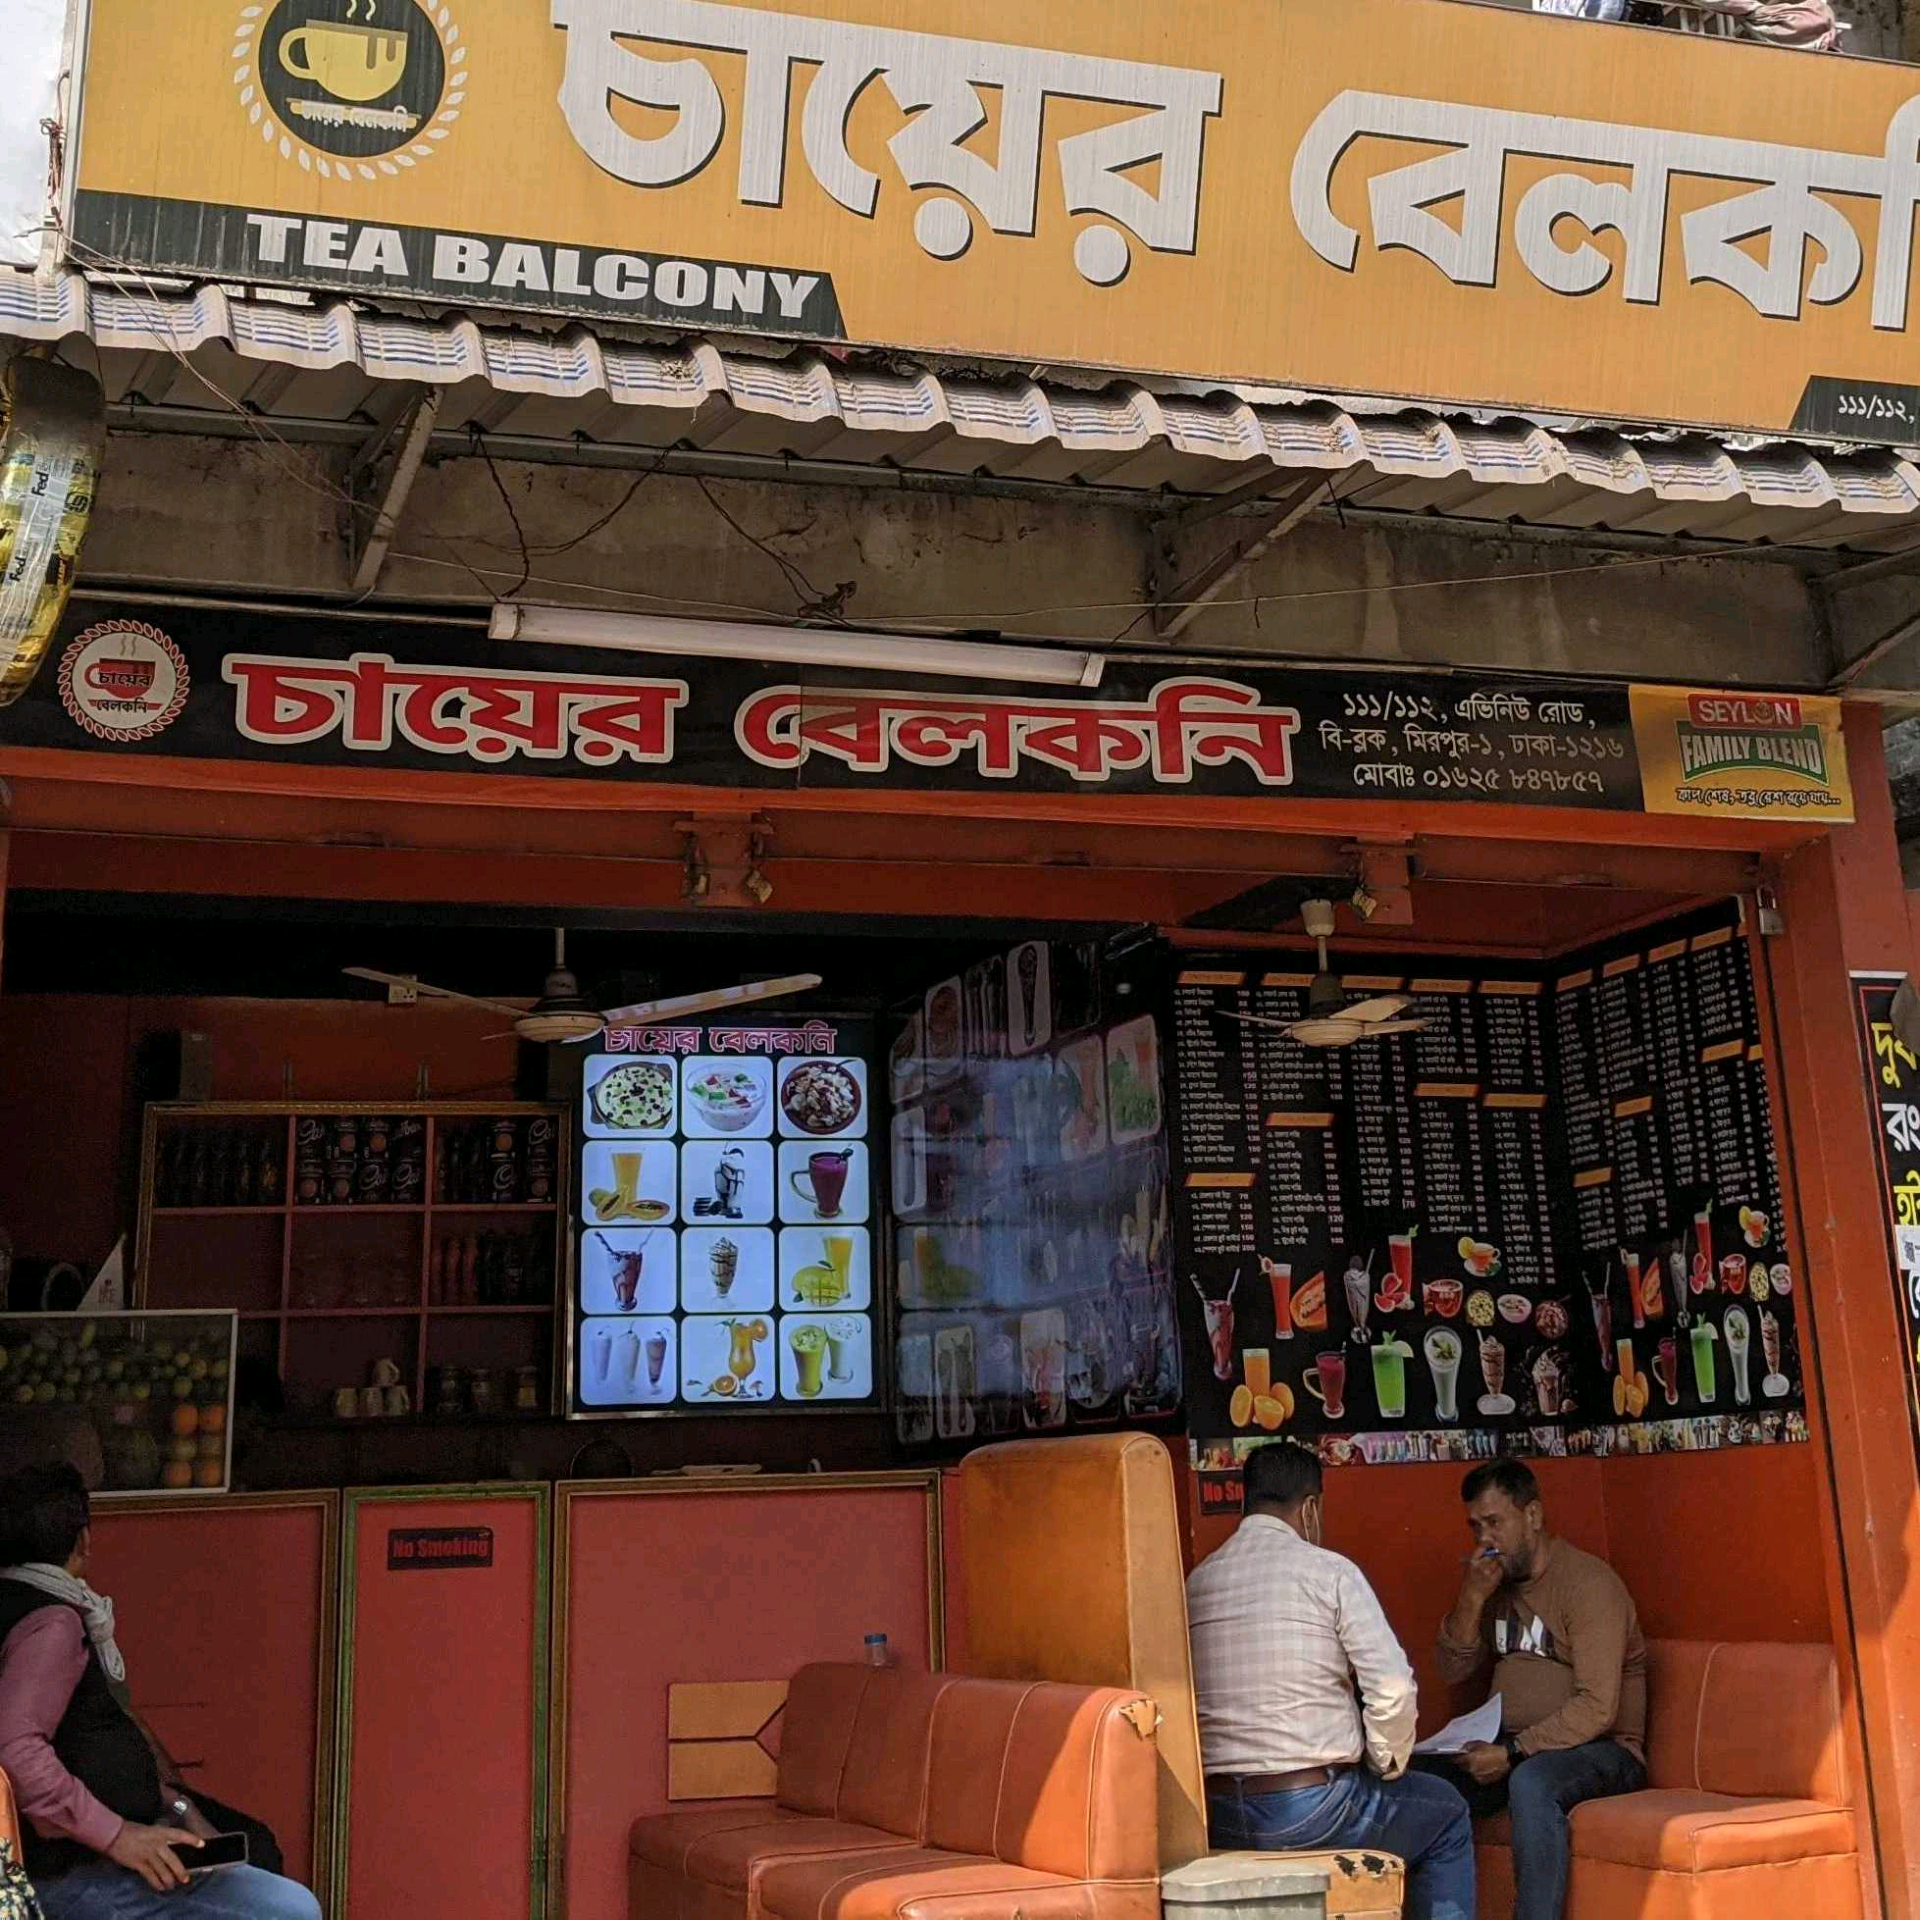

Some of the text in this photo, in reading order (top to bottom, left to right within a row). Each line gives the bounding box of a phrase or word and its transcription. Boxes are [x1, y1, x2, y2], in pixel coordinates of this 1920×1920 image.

[551, 0, 1223, 287] চায়ের
[247, 213, 820, 318] TEA BALCONY
[221, 652, 1300, 785] চায়ের বেলকনি
[1343, 691, 1448, 724] ১১১/১১২,
[1454, 692, 1531, 722] এভিনিউ
[1699, 700, 1794, 725] SEYLON
[1508, 733, 1624, 761] ঢাকা-১২১৬
[1680, 735, 1822, 775] FAMILY BLEND
[1354, 762, 1604, 792] মোবাঃ ০১৬২৫ ৮৪৭৮৫৭
[603, 1020, 838, 1055] চায়ের বেলকনি
[393, 1537, 488, 1558] No Smoking
